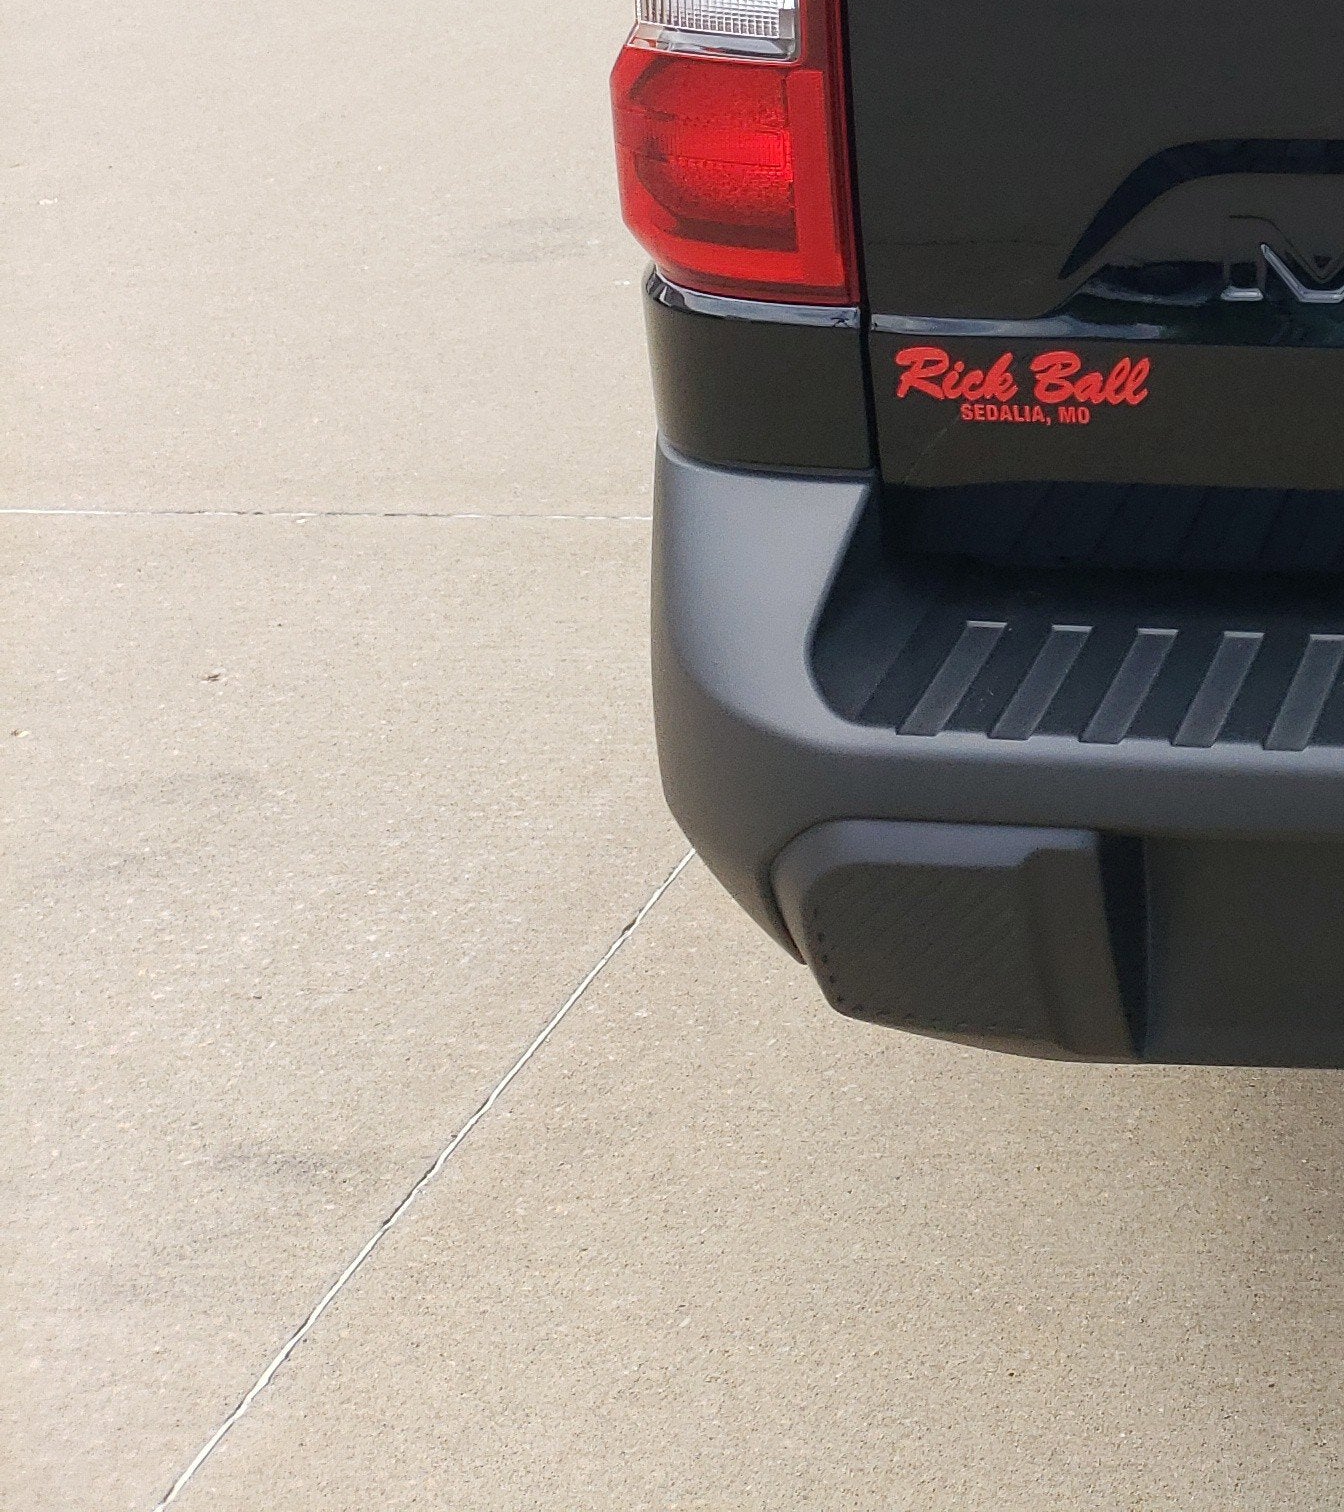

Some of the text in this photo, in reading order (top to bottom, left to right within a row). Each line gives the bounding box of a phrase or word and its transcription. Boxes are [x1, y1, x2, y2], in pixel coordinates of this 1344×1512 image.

[895, 346, 1151, 406] Rick Ball
[960, 403, 1091, 425] SEDALIA, MO
